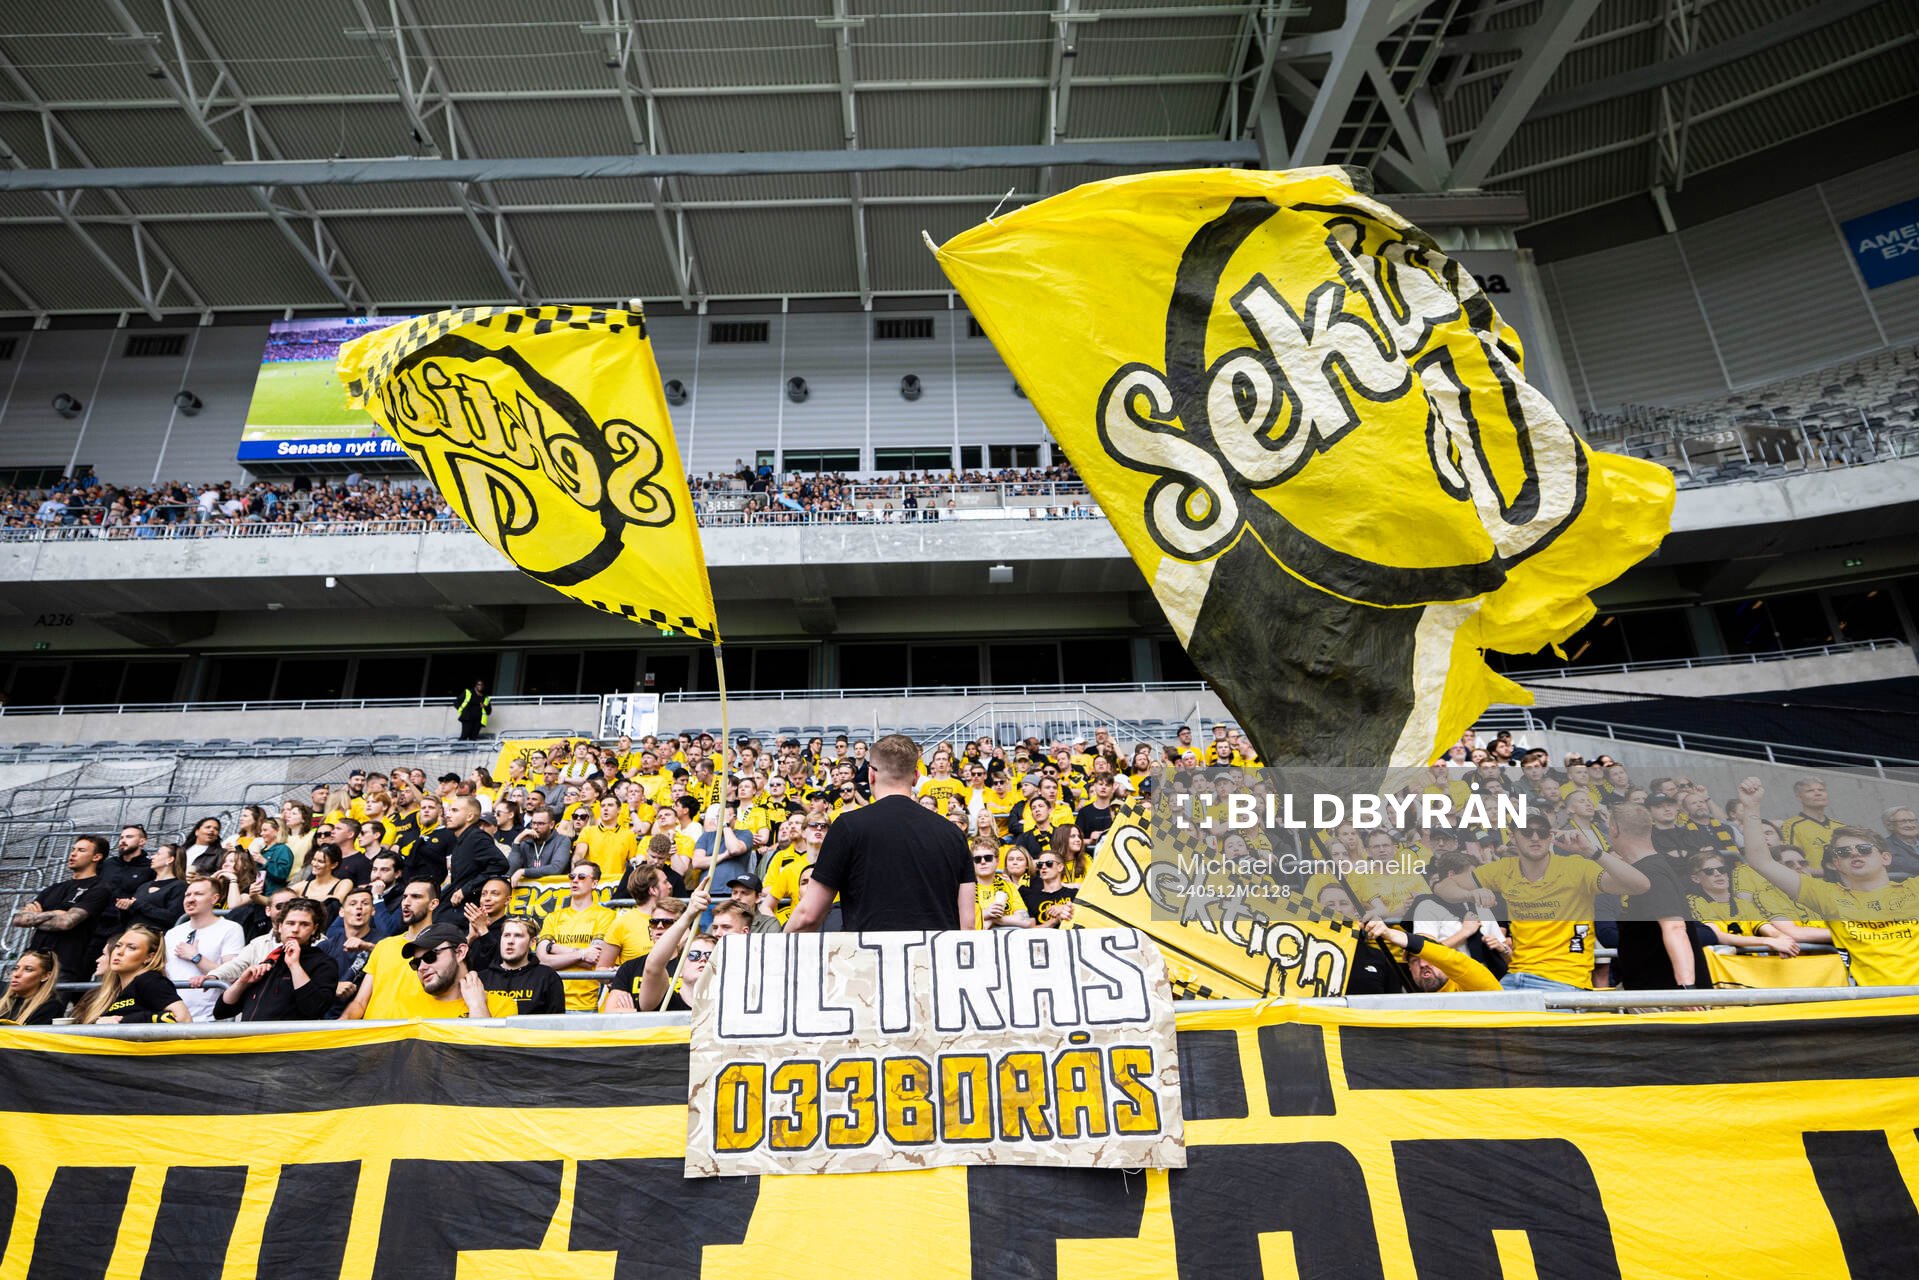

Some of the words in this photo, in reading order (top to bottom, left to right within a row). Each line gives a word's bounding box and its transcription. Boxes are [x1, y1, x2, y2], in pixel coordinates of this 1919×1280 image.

[1859, 222, 1919, 254] AME
[1880, 237, 1919, 260] EX
[277, 442, 342, 455] Senaste
[346, 442, 376, 456] nytt
[380, 440, 405, 453] fin
[34, 613, 74, 627] A236
[1098, 826, 1347, 998] Sektion
[717, 928, 1151, 1039] ULTRAS
[713, 1031, 1162, 1154] 033BORÅS
